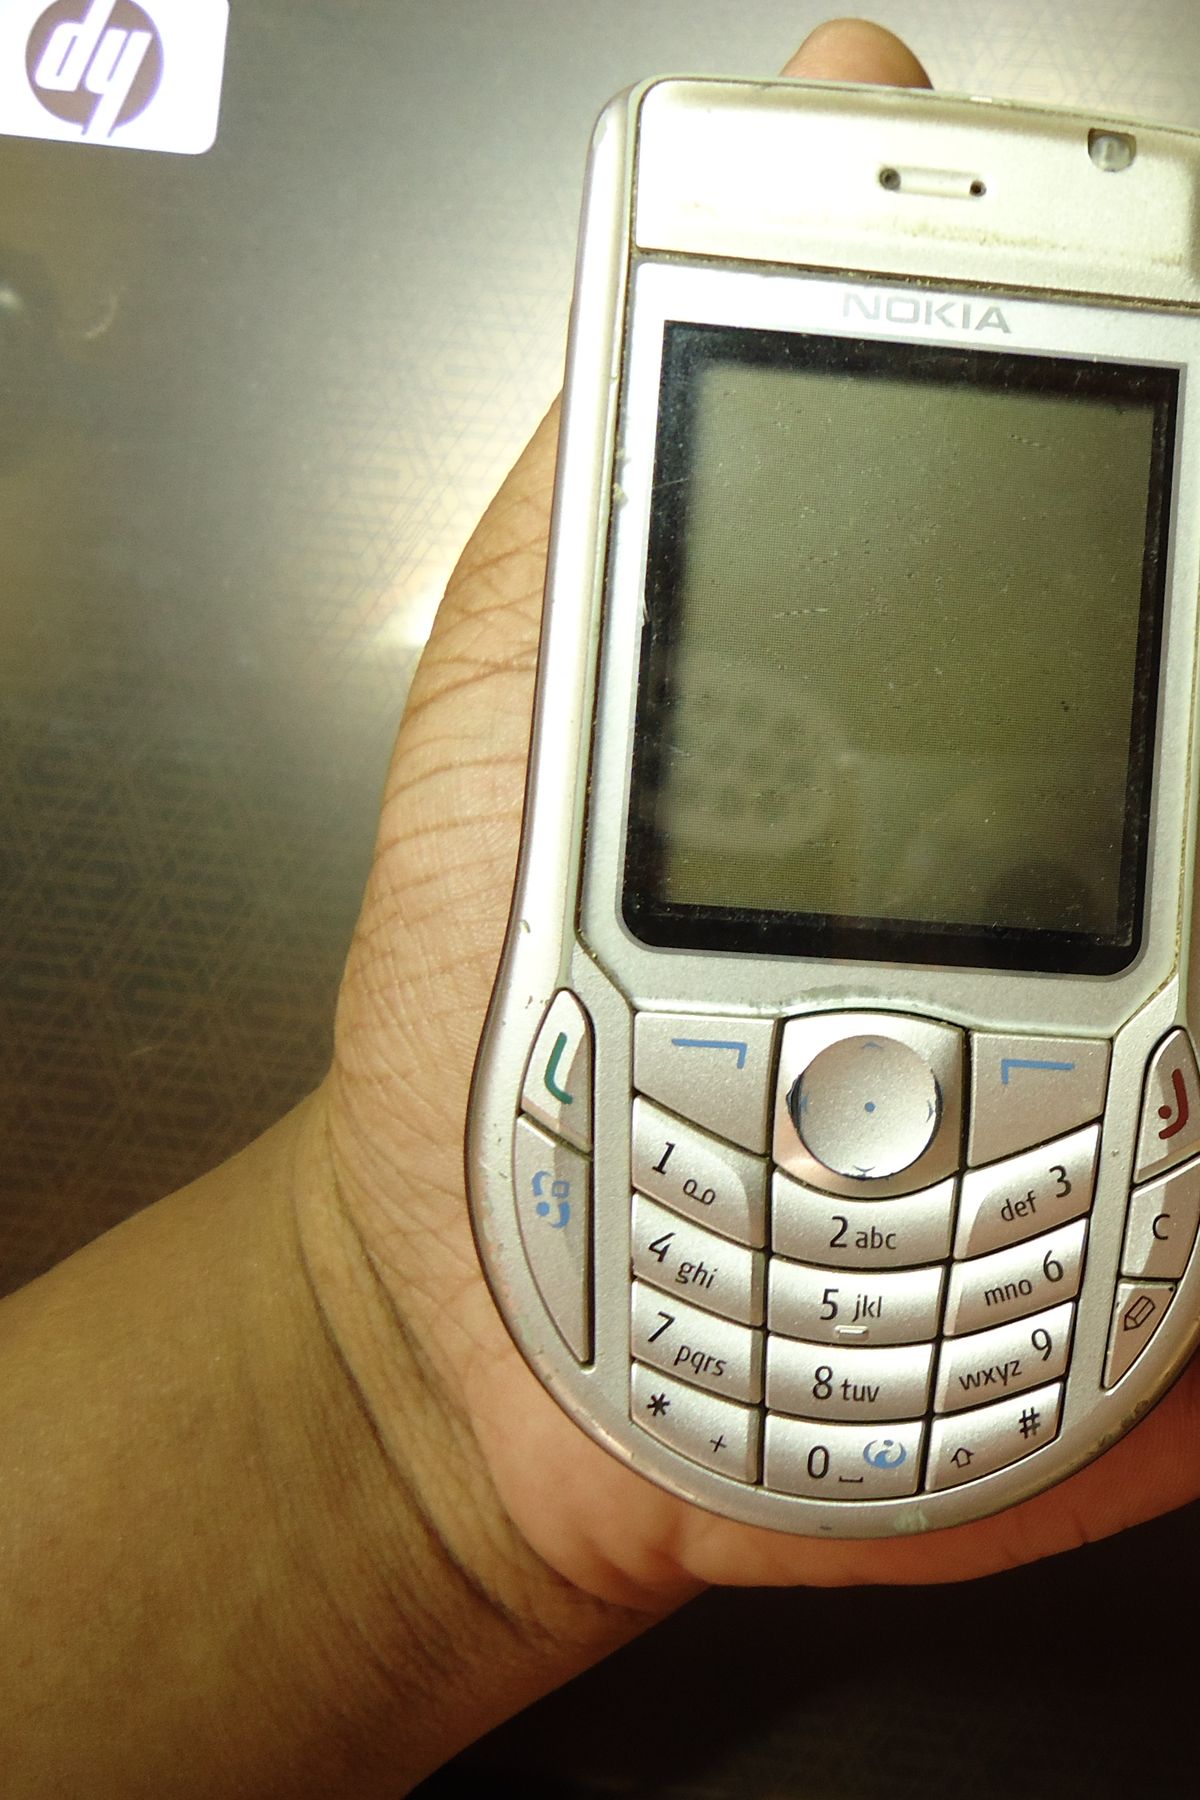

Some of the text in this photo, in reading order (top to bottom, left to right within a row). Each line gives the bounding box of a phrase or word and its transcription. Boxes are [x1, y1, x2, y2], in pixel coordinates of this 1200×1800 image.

[842, 292, 1012, 334] NOKIA
[652, 1141, 676, 1175] 1
[1000, 1165, 1072, 1222] def 3
[829, 1215, 897, 1250] 2 abc
[648, 1232, 718, 1289] 4 ghi
[984, 1250, 1064, 1306] mno 6
[819, 1288, 882, 1322] 5 jkl
[647, 1311, 727, 1376] 7 pqrs
[959, 1328, 1053, 1390] wxyz 9
[812, 1365, 880, 1402] 8 tuv
